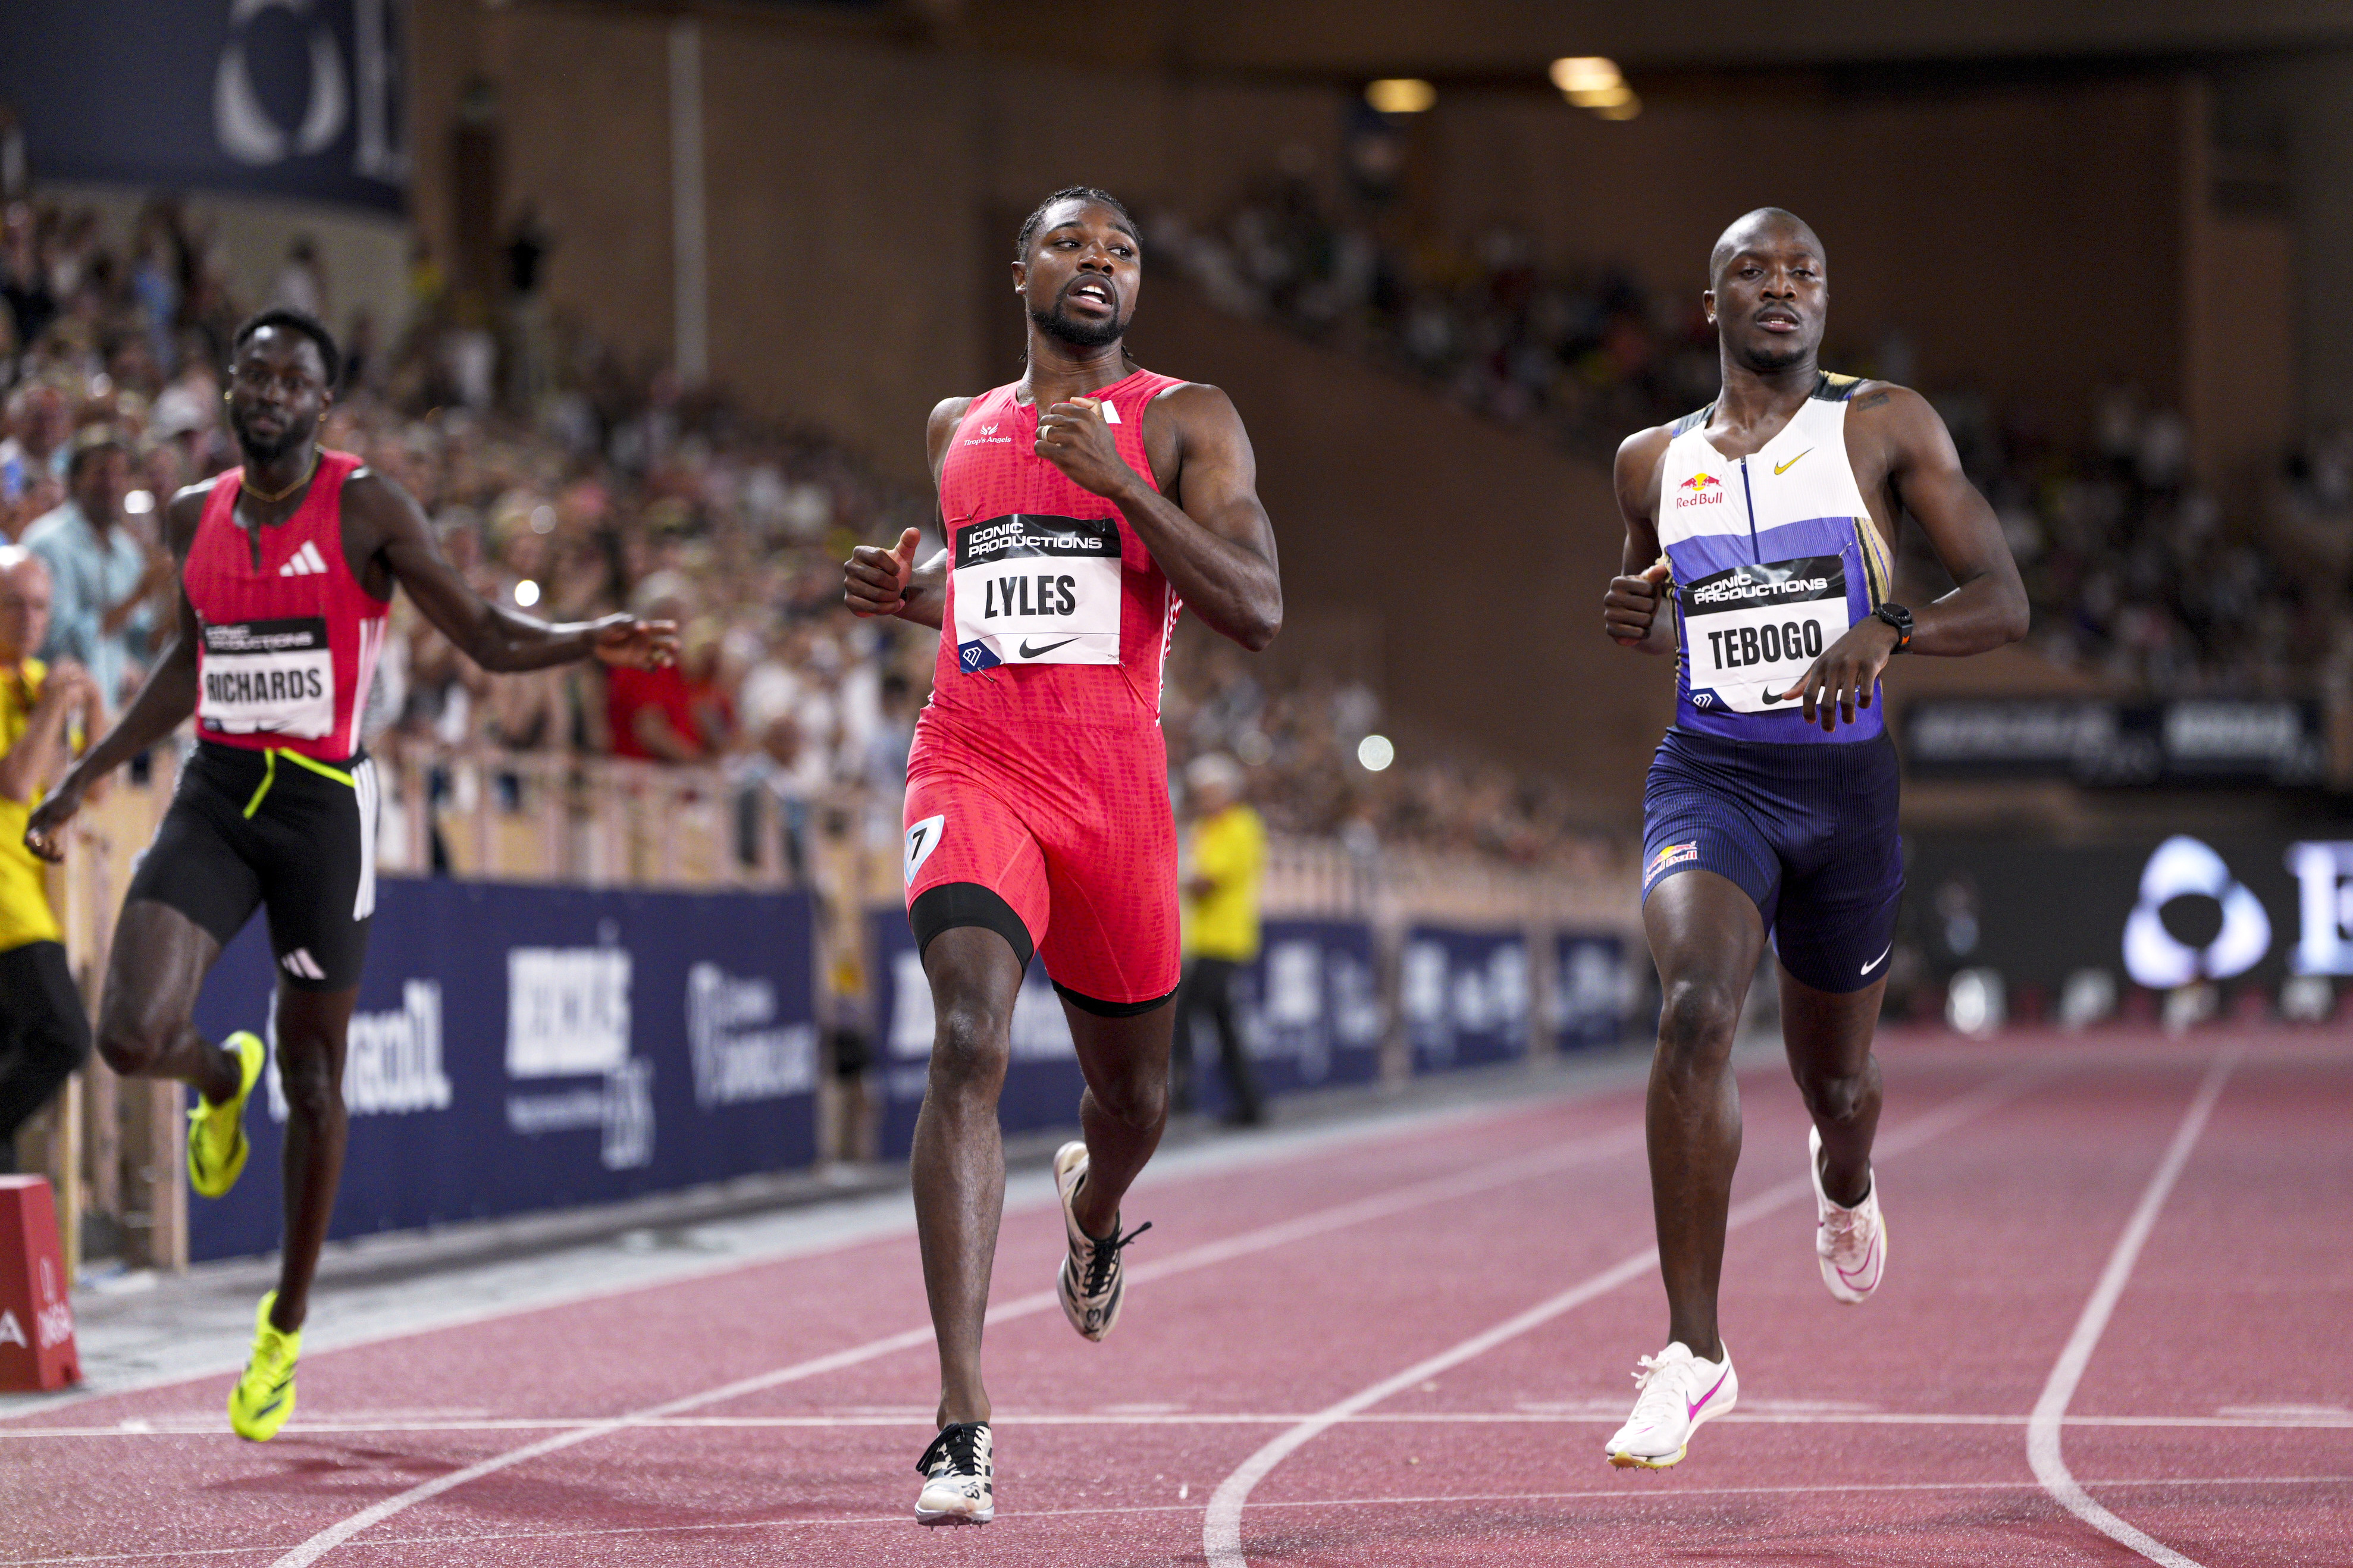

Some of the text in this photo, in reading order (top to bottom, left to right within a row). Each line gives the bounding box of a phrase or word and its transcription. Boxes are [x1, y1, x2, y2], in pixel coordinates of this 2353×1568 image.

[964, 437, 986, 446] Tirop's
[1677, 492, 1722, 509] Red Bull
[969, 522, 1024, 545] ICONIC
[968, 535, 1103, 558] PRODUCTIONS
[985, 575, 1076, 620] LYLES
[1694, 577, 1828, 605] PRODUCTIONS
[1708, 619, 1823, 670] TEBOGO
[206, 669, 322, 703] RICHARDS
[911, 827, 928, 862] 7
[1666, 850, 1697, 867] Bull
